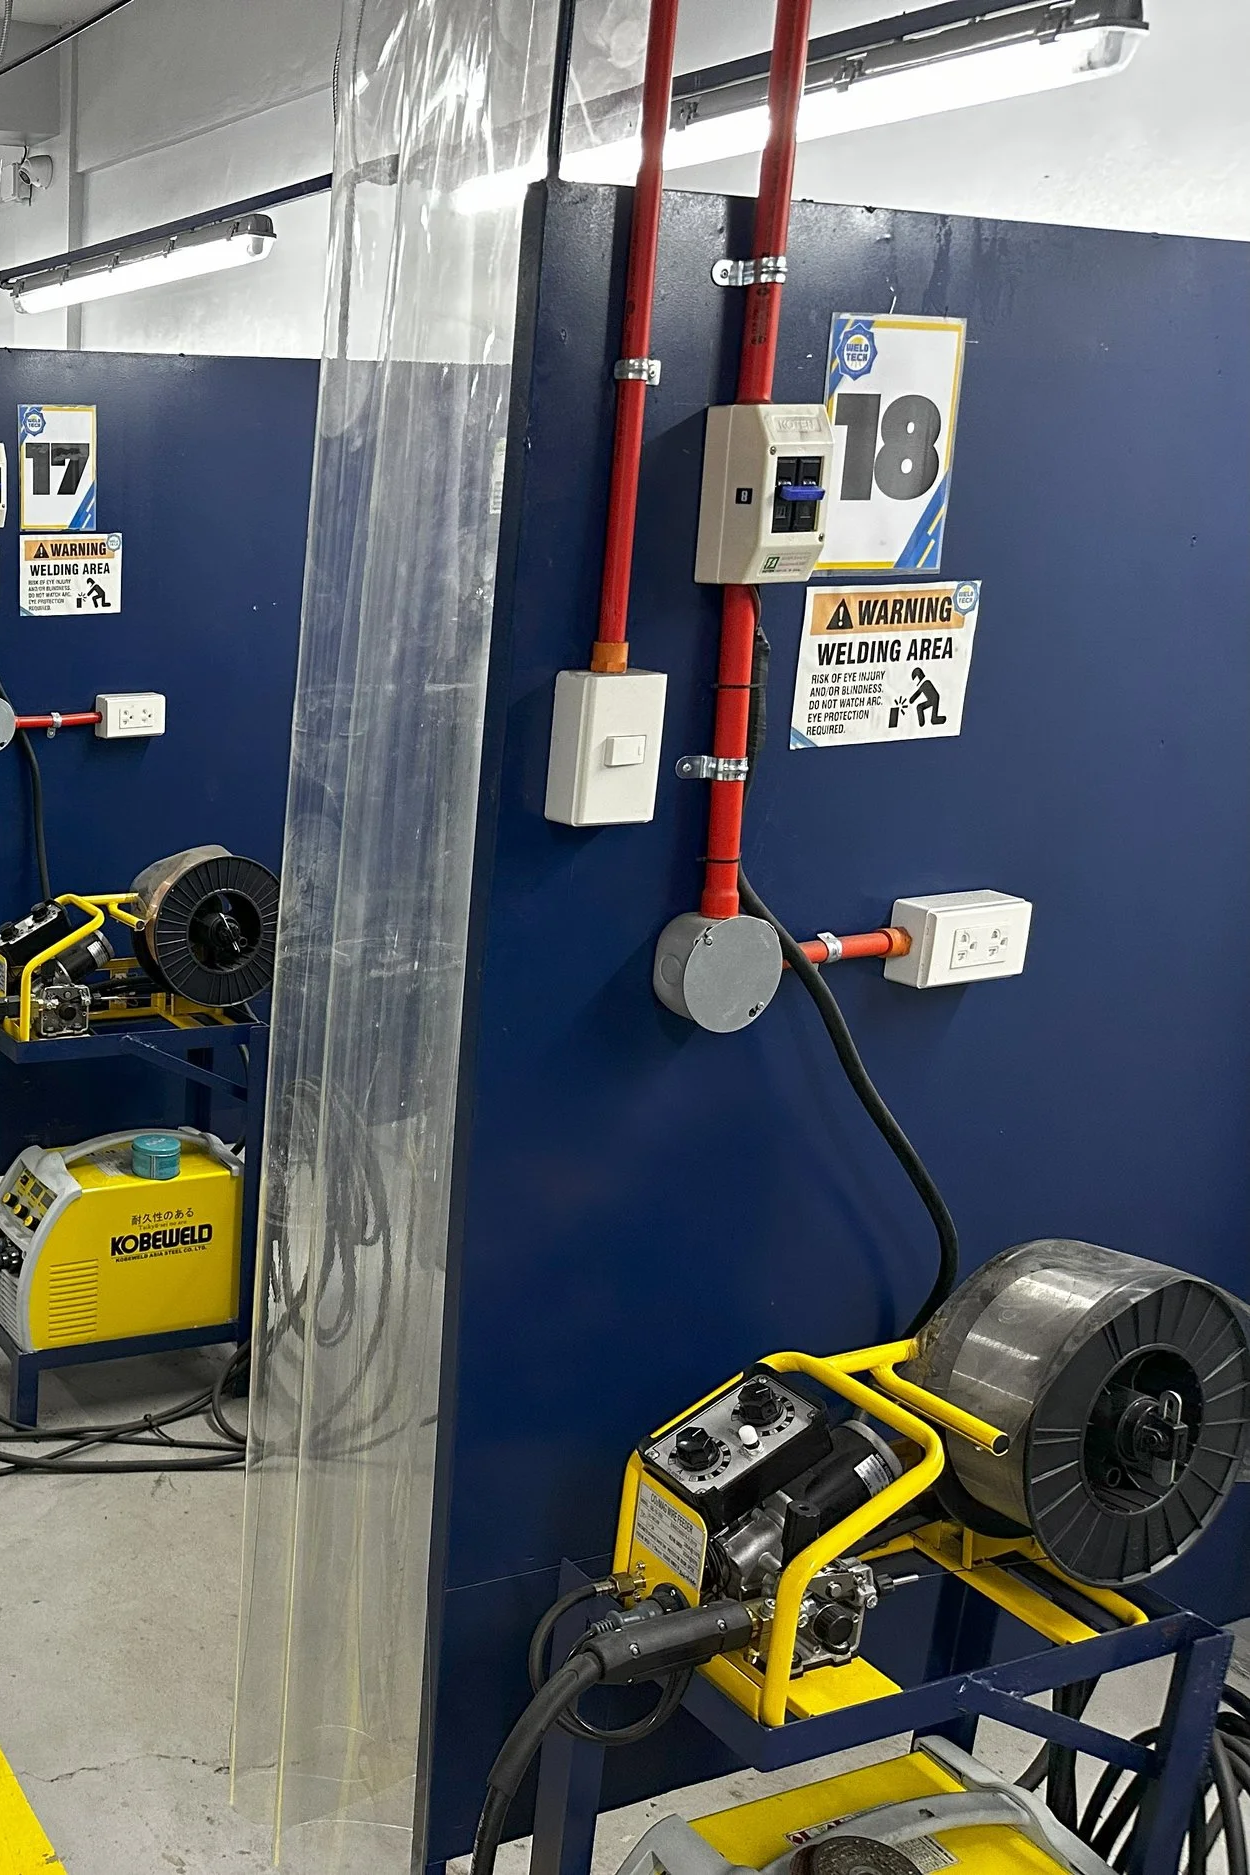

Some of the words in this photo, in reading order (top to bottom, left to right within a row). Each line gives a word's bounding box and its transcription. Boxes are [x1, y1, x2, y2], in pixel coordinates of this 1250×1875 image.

[846, 343, 869, 352] WELD
[846, 353, 868, 362] TECH
[835, 393, 941, 500] 18
[25, 443, 90, 495] 17
[50, 542, 106, 557] WARNING
[30, 563, 79, 576] WELDING
[83, 563, 110, 574] AREA
[858, 597, 952, 626] WARNING
[817, 639, 901, 666] WELDING
[906, 637, 953, 661] AREA
[811, 673, 829, 684] RISK
[831, 673, 842, 683] OF
[844, 672, 857, 682] EYE
[859, 671, 886, 681] INJURY
[810, 686, 840, 697] AND/OR
[841, 683, 884, 695] BLINDNESS.
[809, 700, 820, 710] DO
[821, 699, 838, 709] NOT
[839, 697, 865, 708] WATCH
[866, 696, 883, 706] ARC.
[807, 712, 822, 723] EYE
[823, 710, 869, 722] PROTECTION
[806, 724, 846, 736] REQUIRED.
[131, 1207, 194, 1225] 耐久性のある
[110, 1224, 212, 1256] KOBEWELD
[115, 1253, 148, 1263] KOBEWELD
